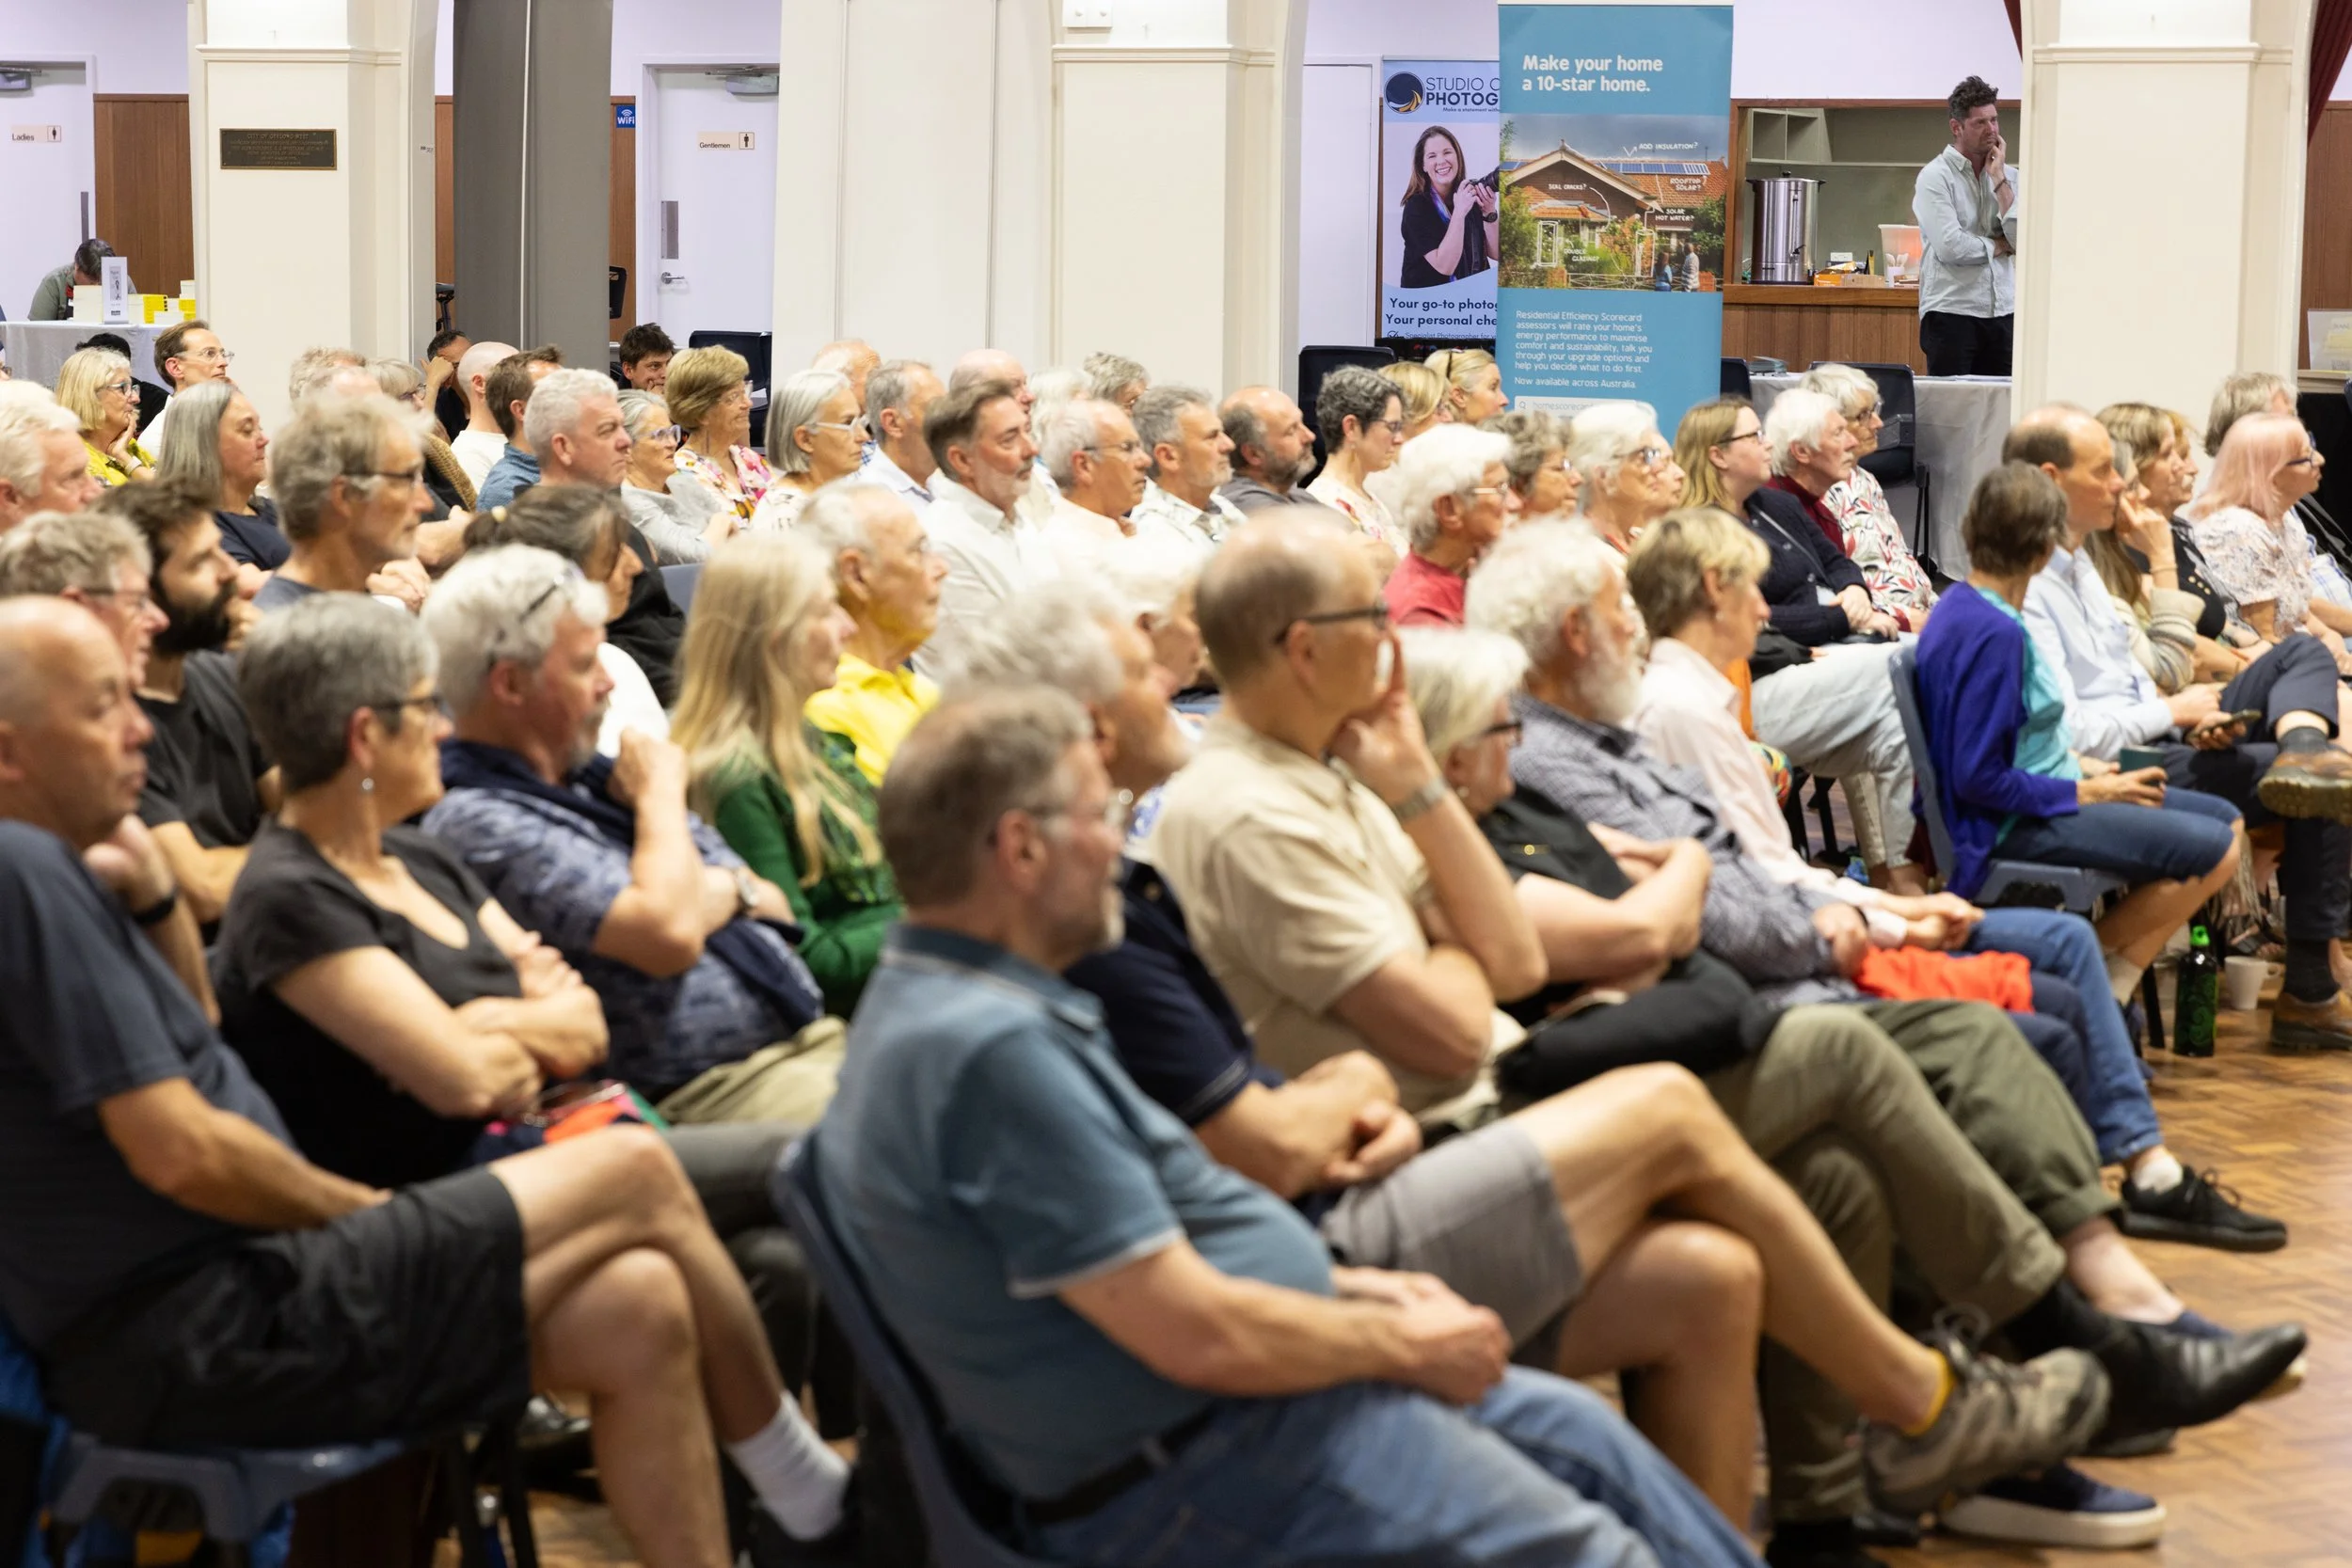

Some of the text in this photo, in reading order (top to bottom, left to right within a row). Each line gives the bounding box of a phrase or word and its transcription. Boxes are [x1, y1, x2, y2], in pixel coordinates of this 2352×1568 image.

[1522, 55, 1663, 74] Make your home
[1426, 77, 1484, 91] STUDIO
[1521, 75, 1651, 92] a 10-star home.
[1426, 92, 1499, 105] PHOTOG
[617, 116, 635, 124] WiFi
[11, 133, 35, 141] Ladies
[1655, 141, 1699, 150] INSULATION?
[1390, 297, 1419, 309] Your
[1422, 299, 1454, 311] go-to
[1386, 313, 1415, 325] Your
[1418, 315, 1472, 327] personal
[1516, 310, 1643, 322] Residential Efficiency Scorecard
[1559, 322, 1572, 330] will
[1573, 322, 1591, 330] rate
[1593, 324, 1611, 332] your
[1613, 324, 1643, 332] home's
[1516, 332, 1648, 342] energy performance to maximise
[1515, 341, 1653, 354] comfort and sustainability, talk you
[1515, 351, 1650, 363] through your upgrade options and
[1515, 361, 1532, 371] help
[1534, 363, 1549, 372] you
[1549, 362, 1578, 371] decide
[1580, 362, 1599, 372] what
[1613, 363, 1624, 372] do
[1625, 364, 1643, 373] first.
[1515, 377, 1533, 386] Now
[1535, 377, 1570, 387] available
